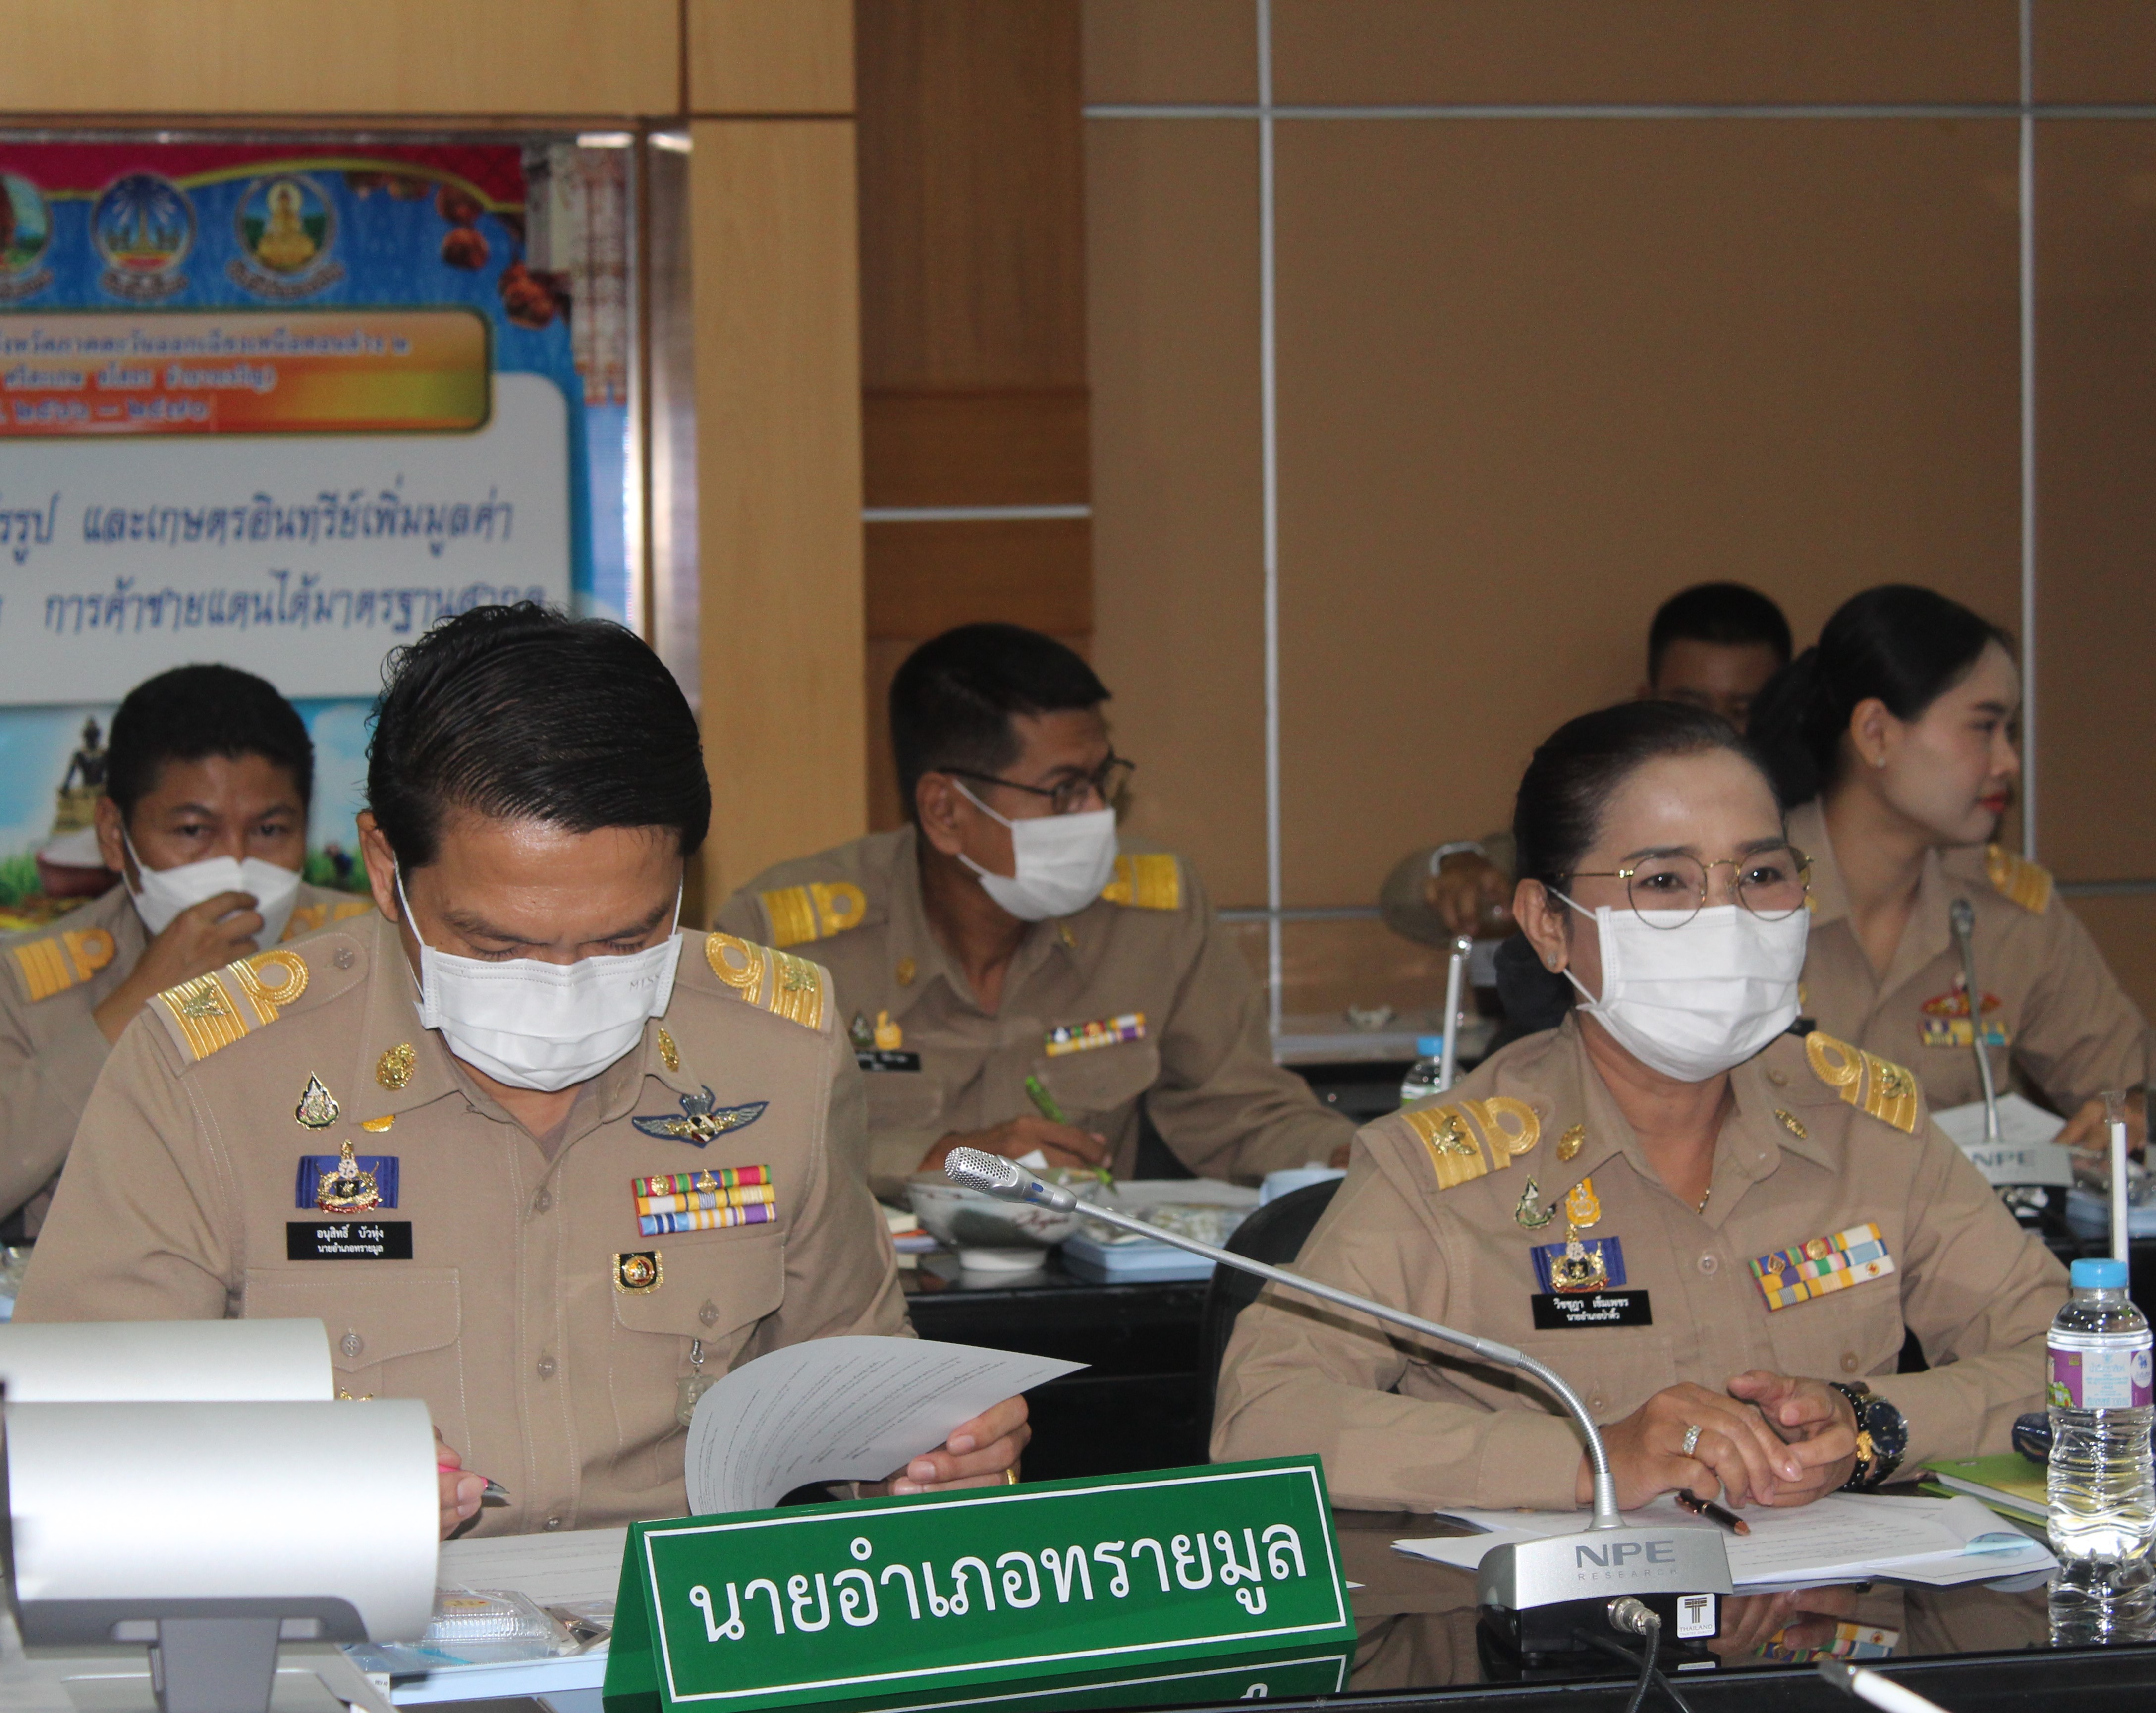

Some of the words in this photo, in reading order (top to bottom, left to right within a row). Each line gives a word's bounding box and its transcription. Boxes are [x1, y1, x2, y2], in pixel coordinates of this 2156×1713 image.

[316, 1224, 350, 1242] อนุสิทธิ์
[317, 1242, 384, 1256] นายอำเภอทรายมูล
[1575, 1540, 1676, 1568] NPE
[689, 1523, 1307, 1642] นายอำเภอทรายมูล
[1578, 1569, 1677, 1580] RESEARCH
